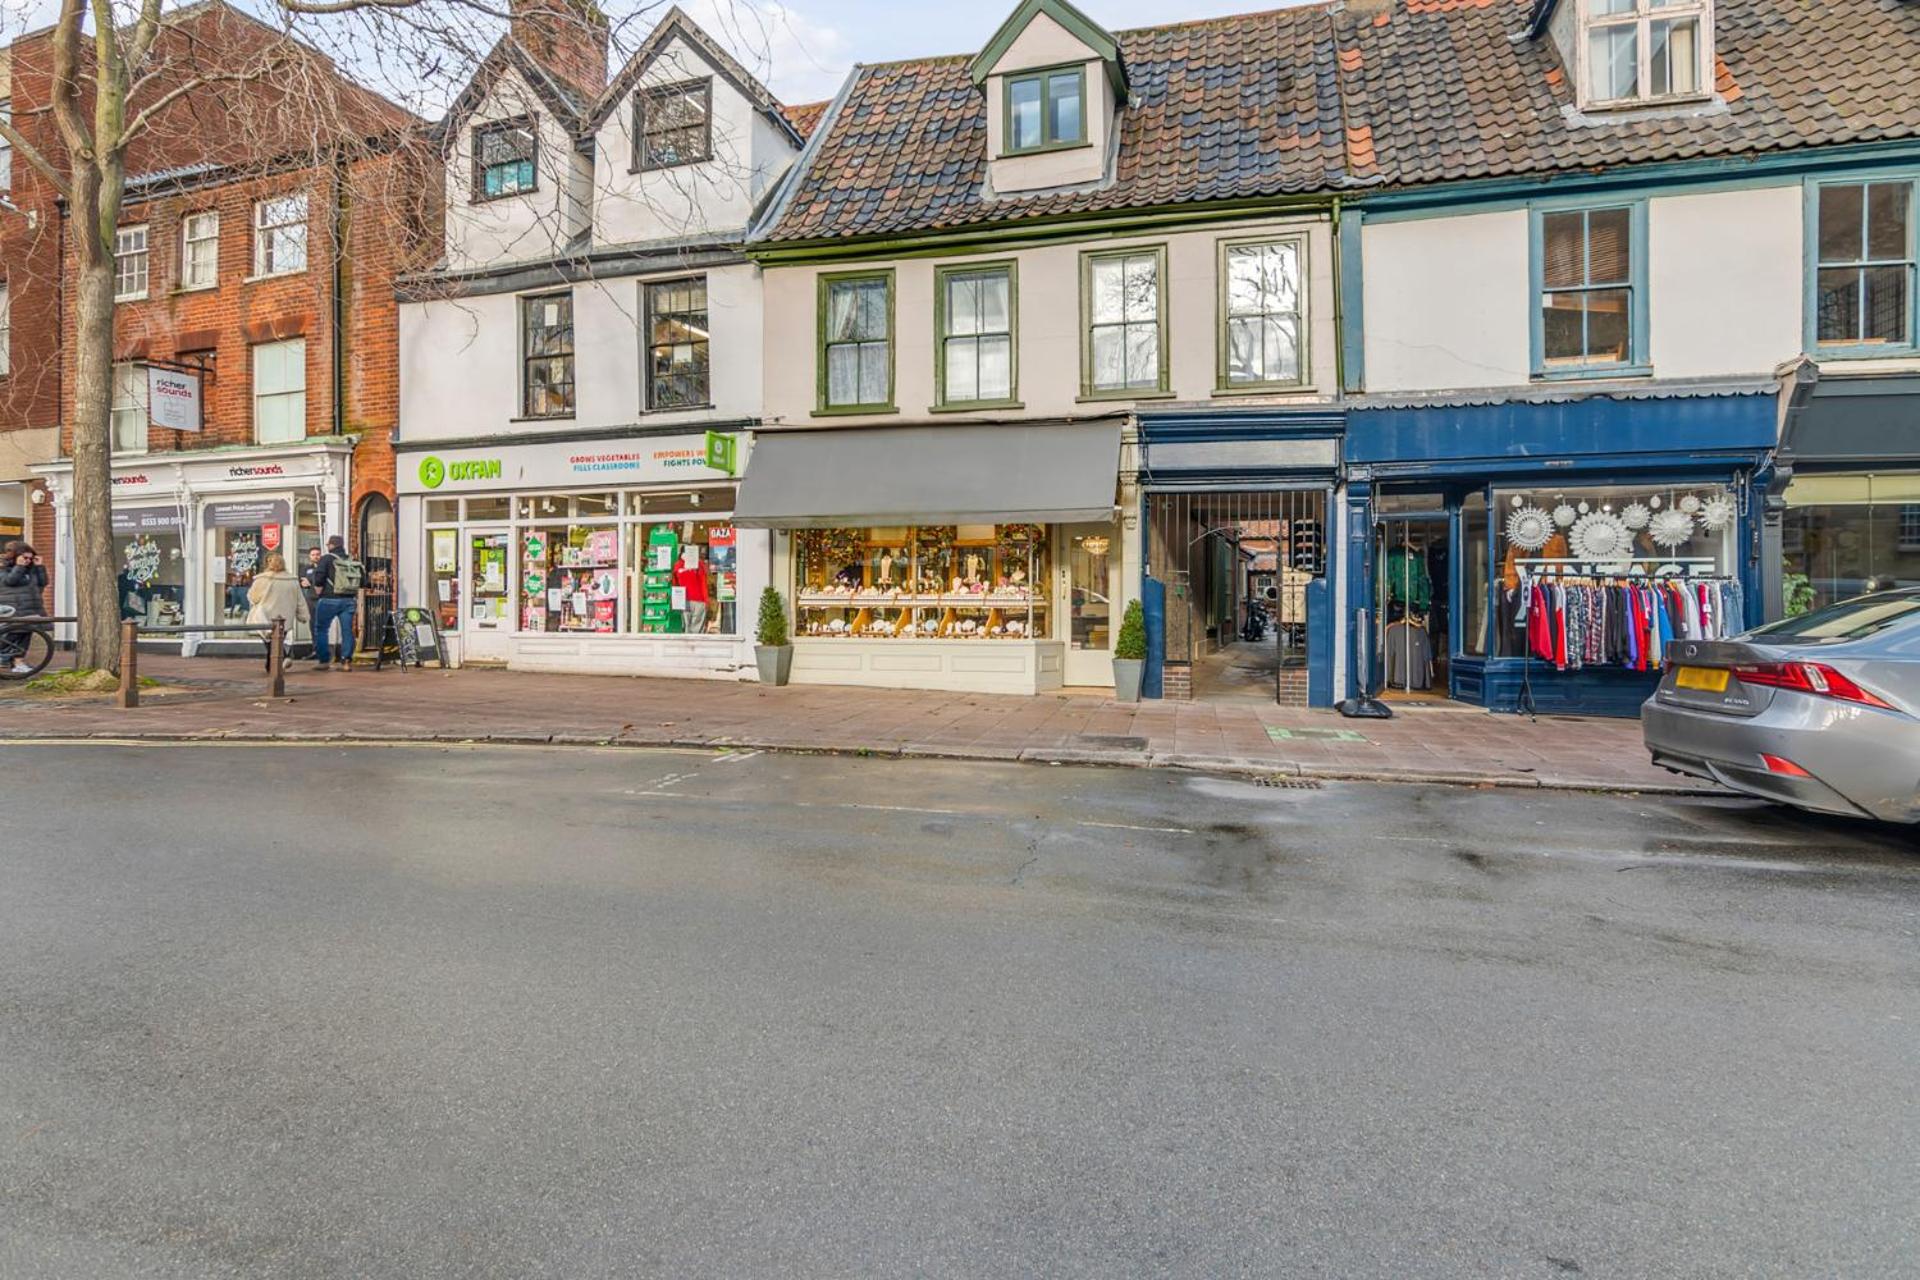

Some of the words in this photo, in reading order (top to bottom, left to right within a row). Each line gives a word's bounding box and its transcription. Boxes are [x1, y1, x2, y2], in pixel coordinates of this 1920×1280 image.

[156, 379, 185, 390] richer
[156, 386, 192, 398] sounds
[570, 456, 595, 464] GROWS
[596, 453, 640, 462] VEGETABLES
[663, 459, 691, 467] FIGHTS
[229, 464, 283, 476] richersounds
[449, 459, 502, 480] OXFAM
[573, 464, 591, 472] FILLS
[592, 462, 640, 471] CLASSROOMS
